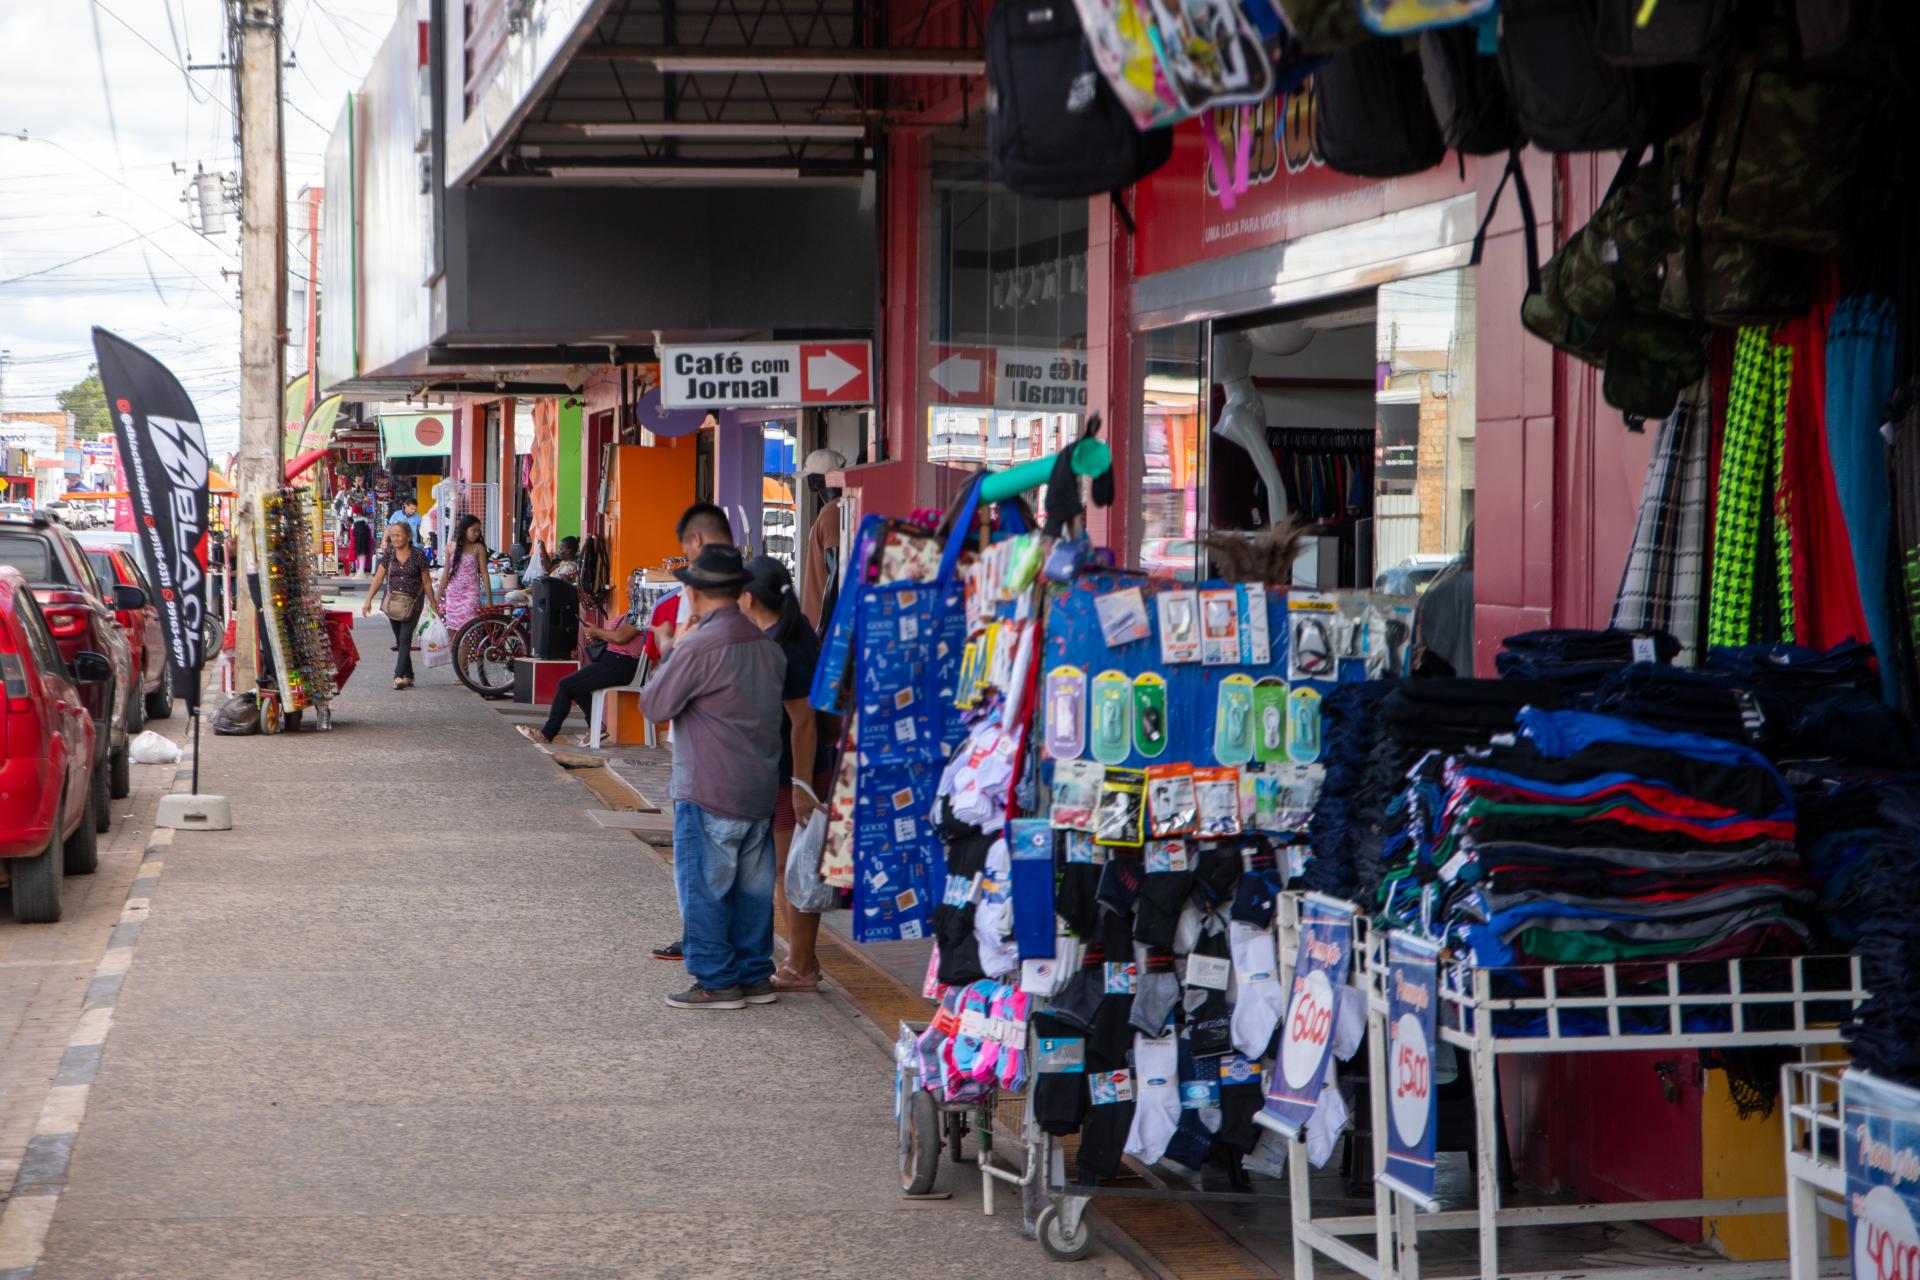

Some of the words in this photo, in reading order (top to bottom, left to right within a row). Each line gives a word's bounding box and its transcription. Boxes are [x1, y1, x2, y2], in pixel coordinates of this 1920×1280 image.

[1221, 221, 1239, 239] LOJA
[1240, 217, 1259, 235] PARA
[675, 351, 743, 376] Café
[751, 359, 789, 374] com
[686, 375, 779, 400] Jornal
[860, 823, 888, 833] GOOD
[865, 926, 893, 937] GOOD
